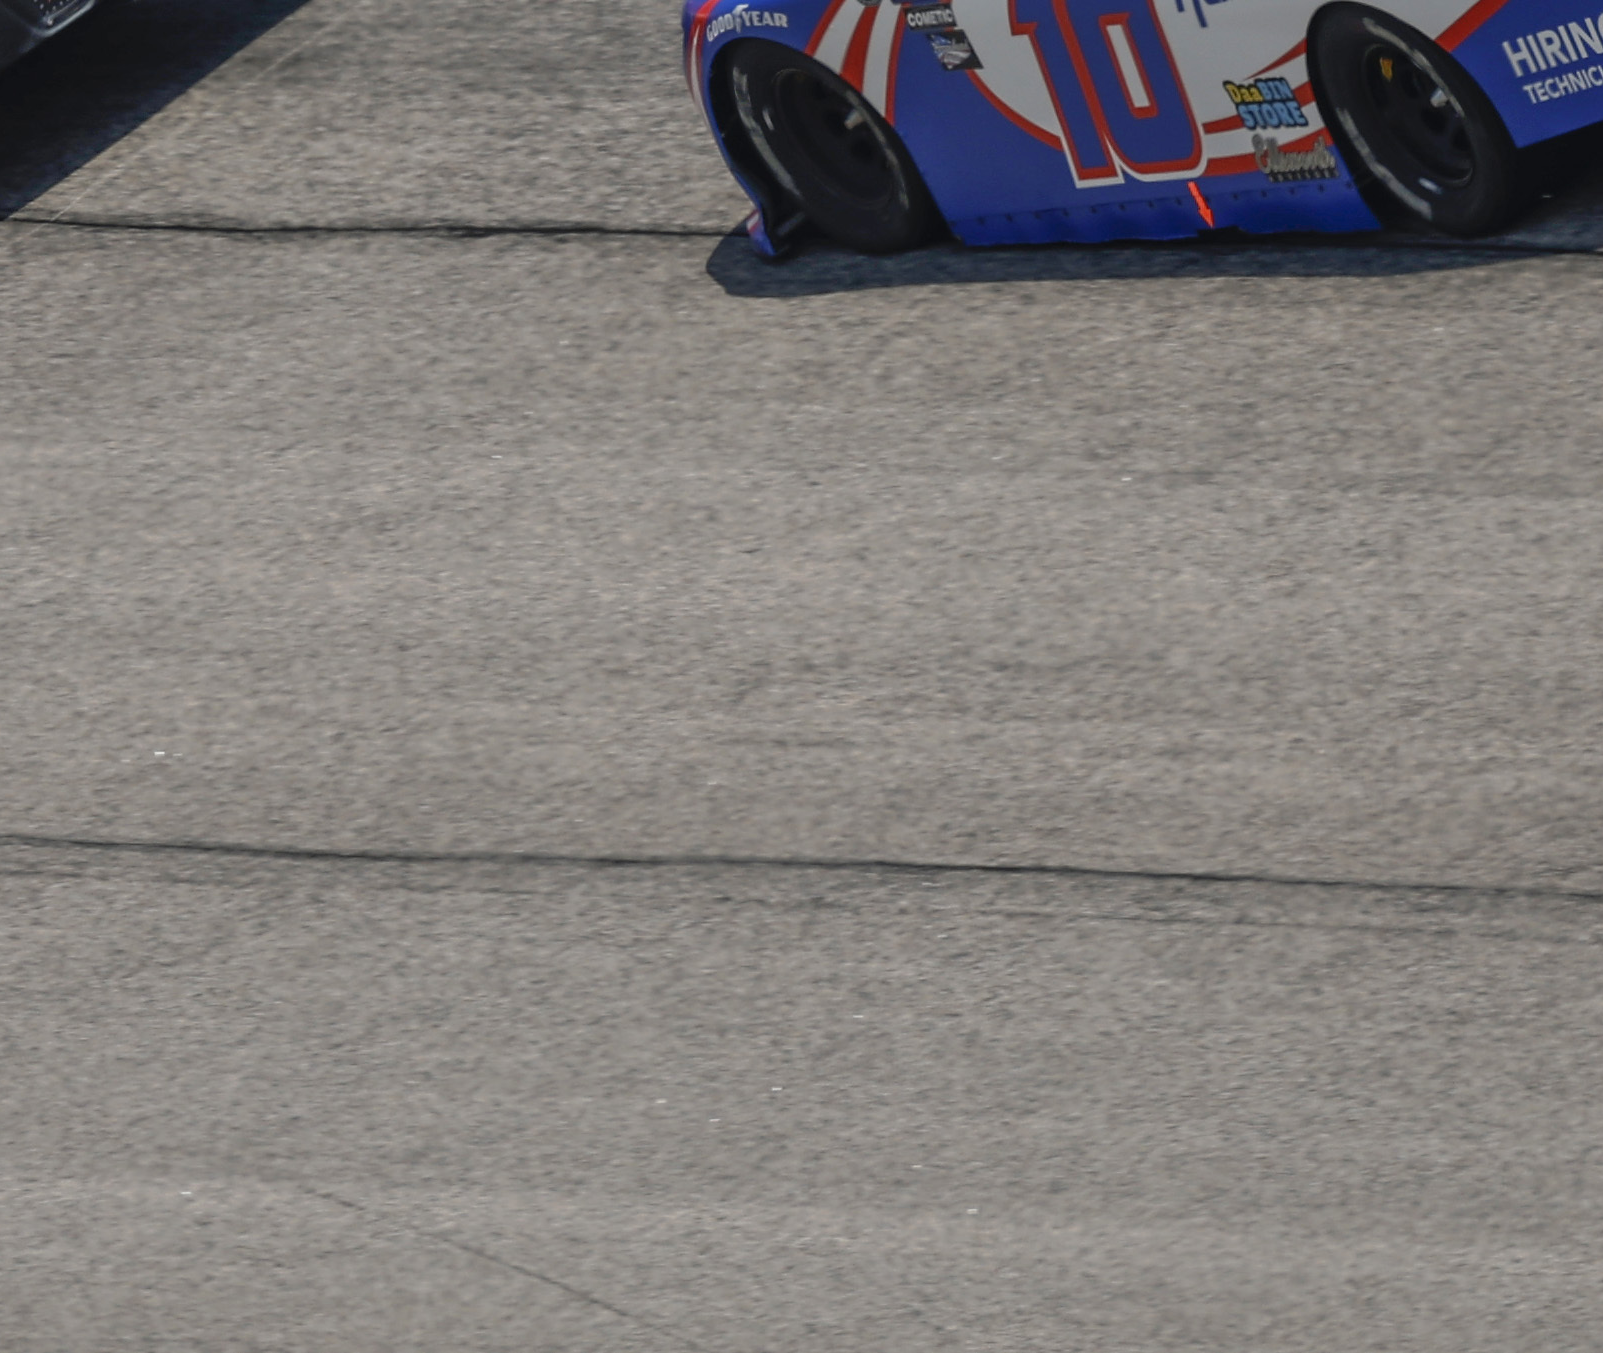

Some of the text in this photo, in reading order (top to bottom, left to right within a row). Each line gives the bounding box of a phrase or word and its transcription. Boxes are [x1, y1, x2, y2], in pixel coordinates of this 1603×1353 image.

[706, 4, 788, 42] GOODYEAR
[907, 10, 953, 27] COMETIC
[1237, 101, 1308, 129] STORE
